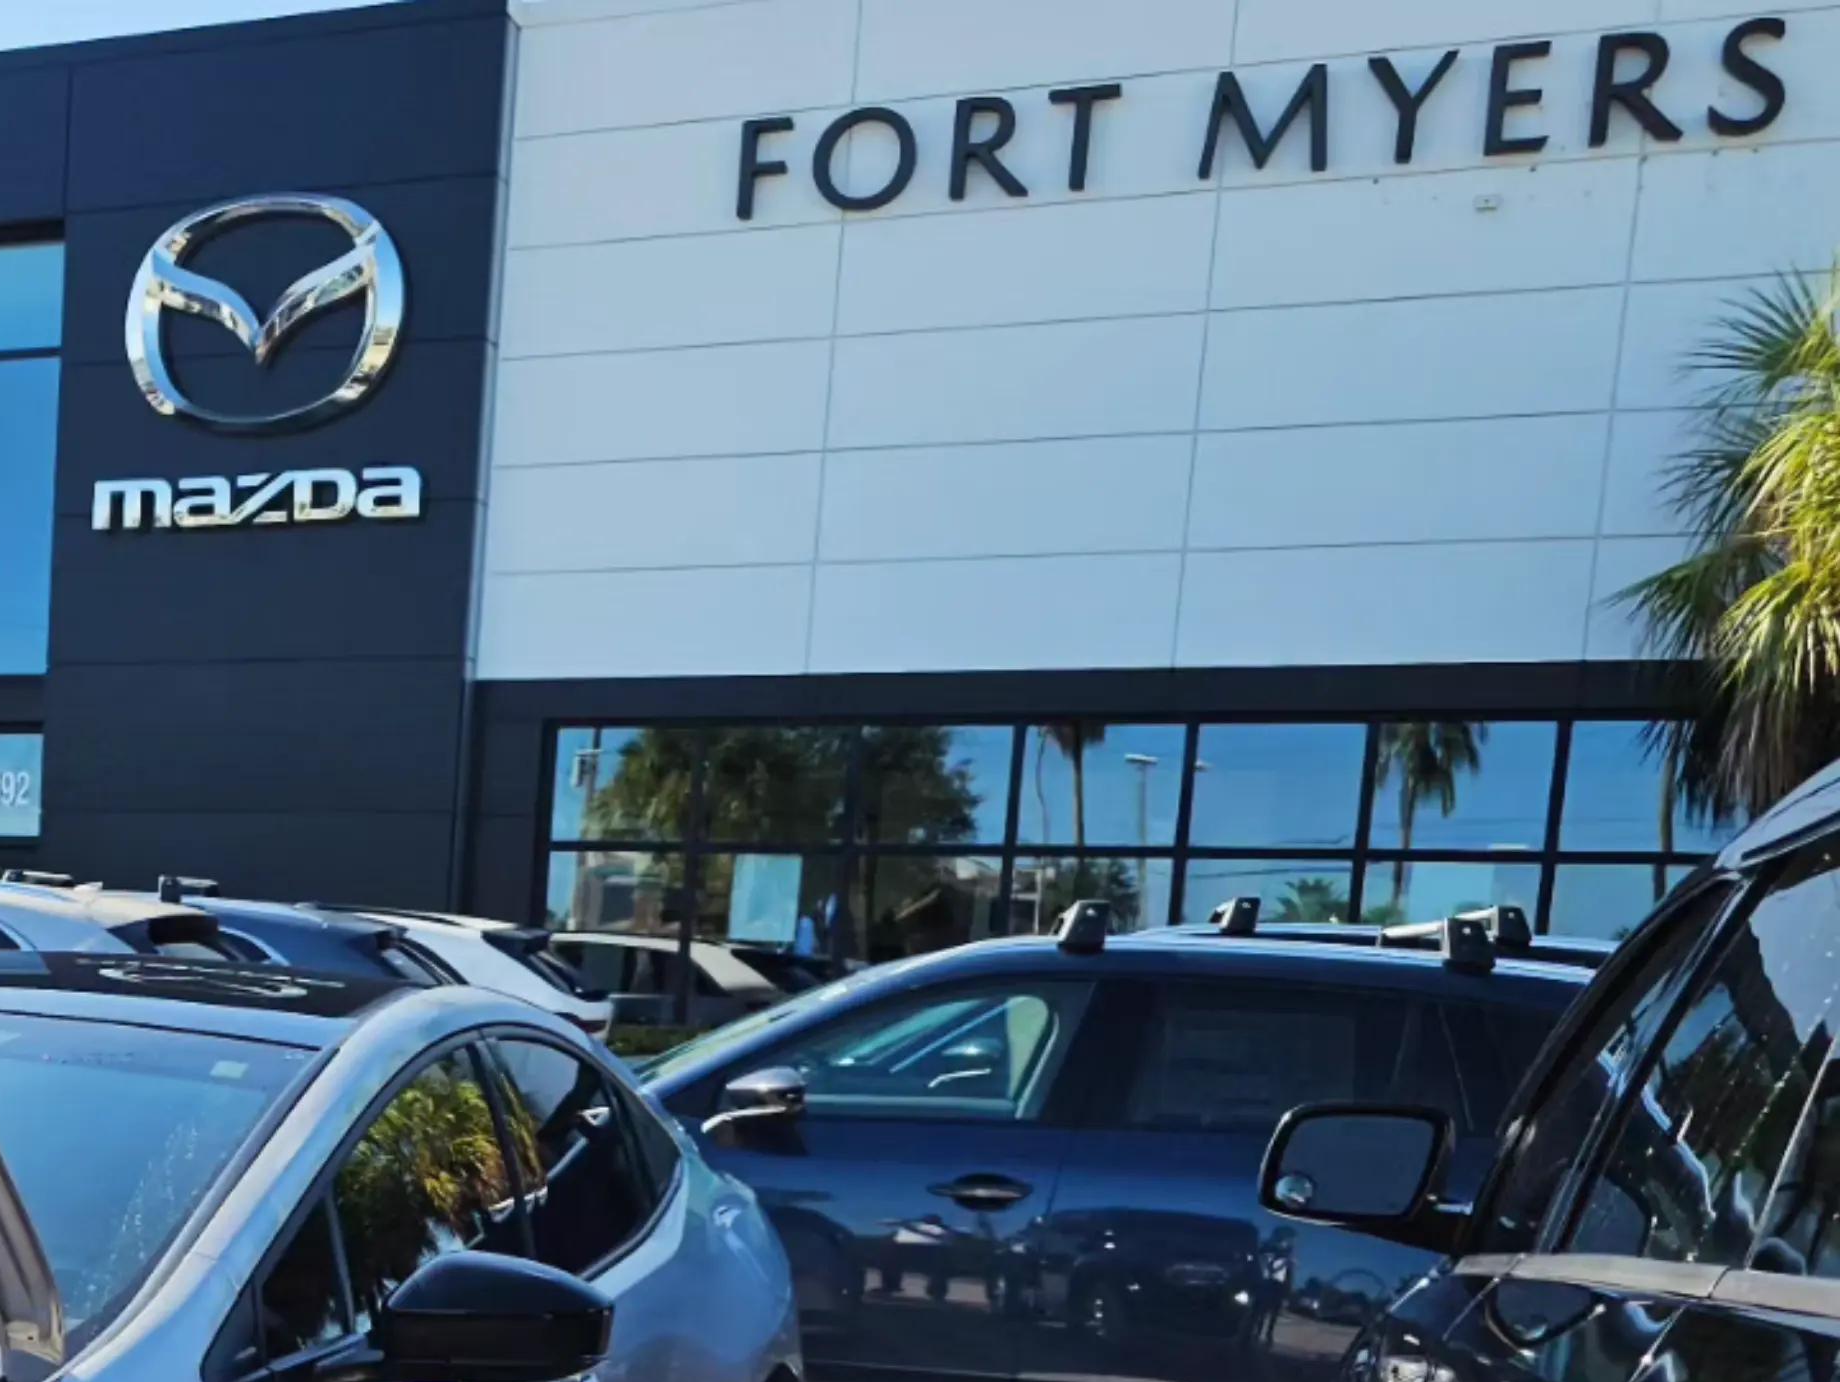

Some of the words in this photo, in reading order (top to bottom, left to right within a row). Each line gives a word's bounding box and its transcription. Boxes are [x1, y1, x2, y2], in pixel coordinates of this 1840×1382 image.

[735, 83, 1122, 220] FORT
[1197, 17, 1787, 180] MYERS
[91, 465, 422, 530] mazda
